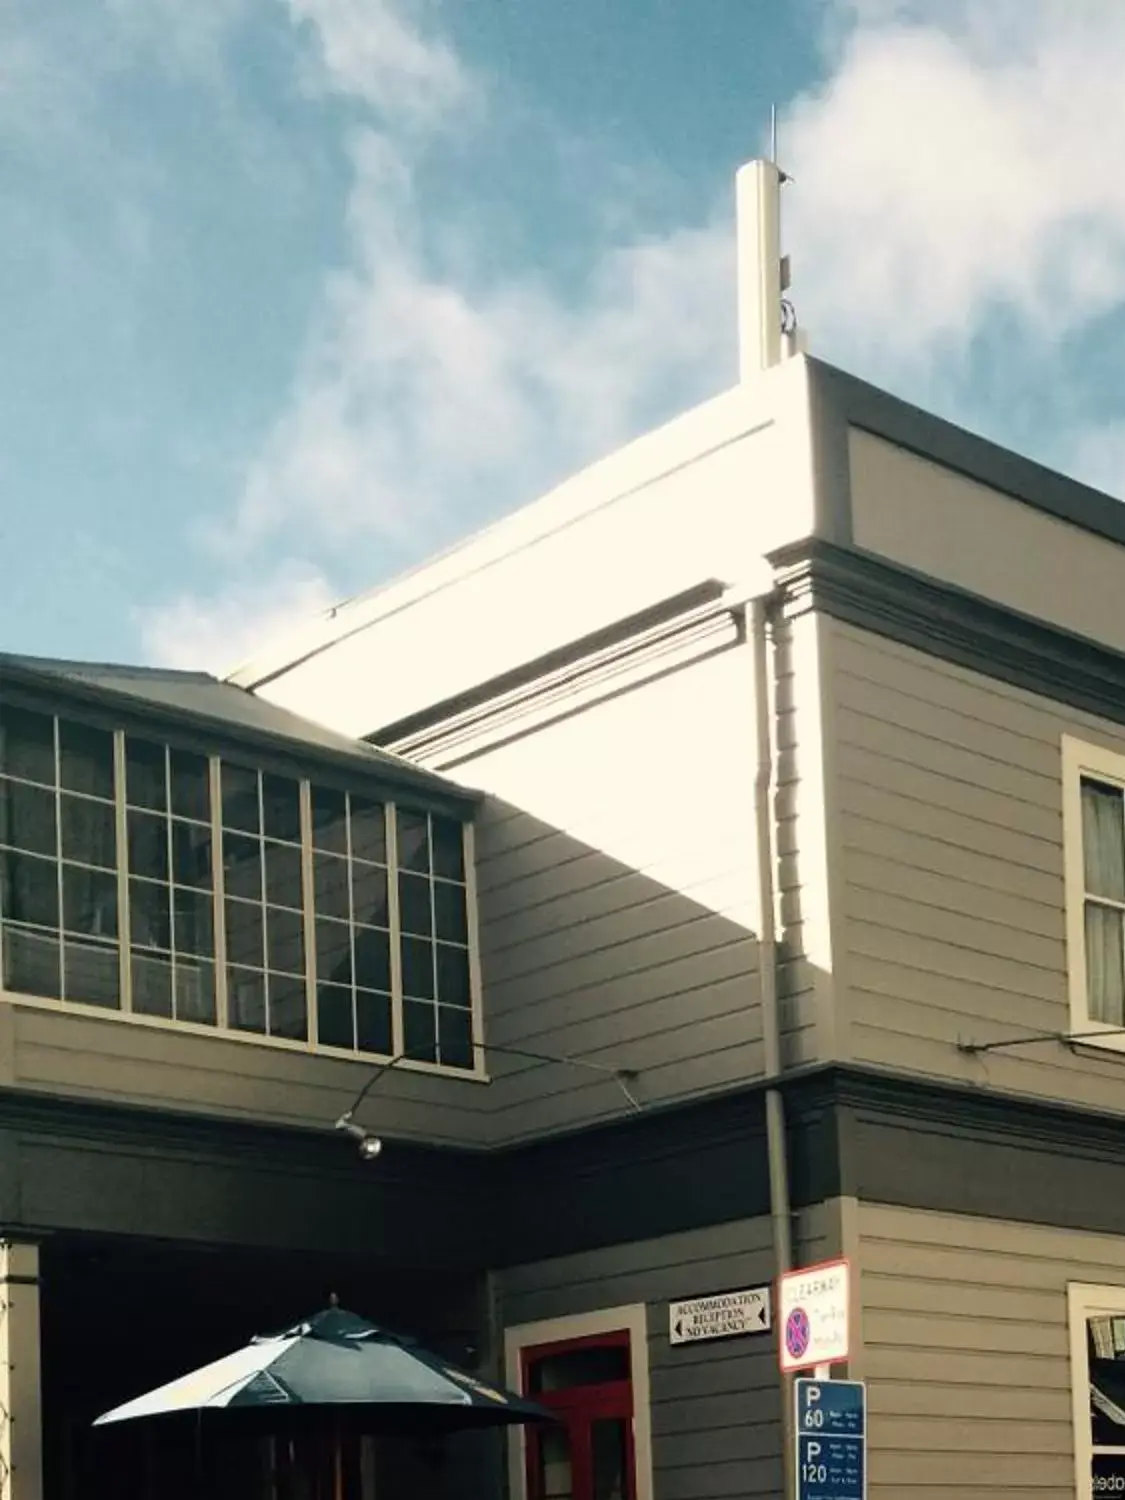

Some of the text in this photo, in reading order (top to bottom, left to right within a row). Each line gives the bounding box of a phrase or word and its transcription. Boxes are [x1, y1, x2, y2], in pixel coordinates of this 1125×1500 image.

[676, 1294, 761, 1315] ACCOMMODATION
[693, 1308, 744, 1324] RECEPTION
[806, 1386, 821, 1407] P
[805, 1409, 824, 1428] 60
[807, 1441, 821, 1462] P
[802, 1464, 827, 1483] 120
